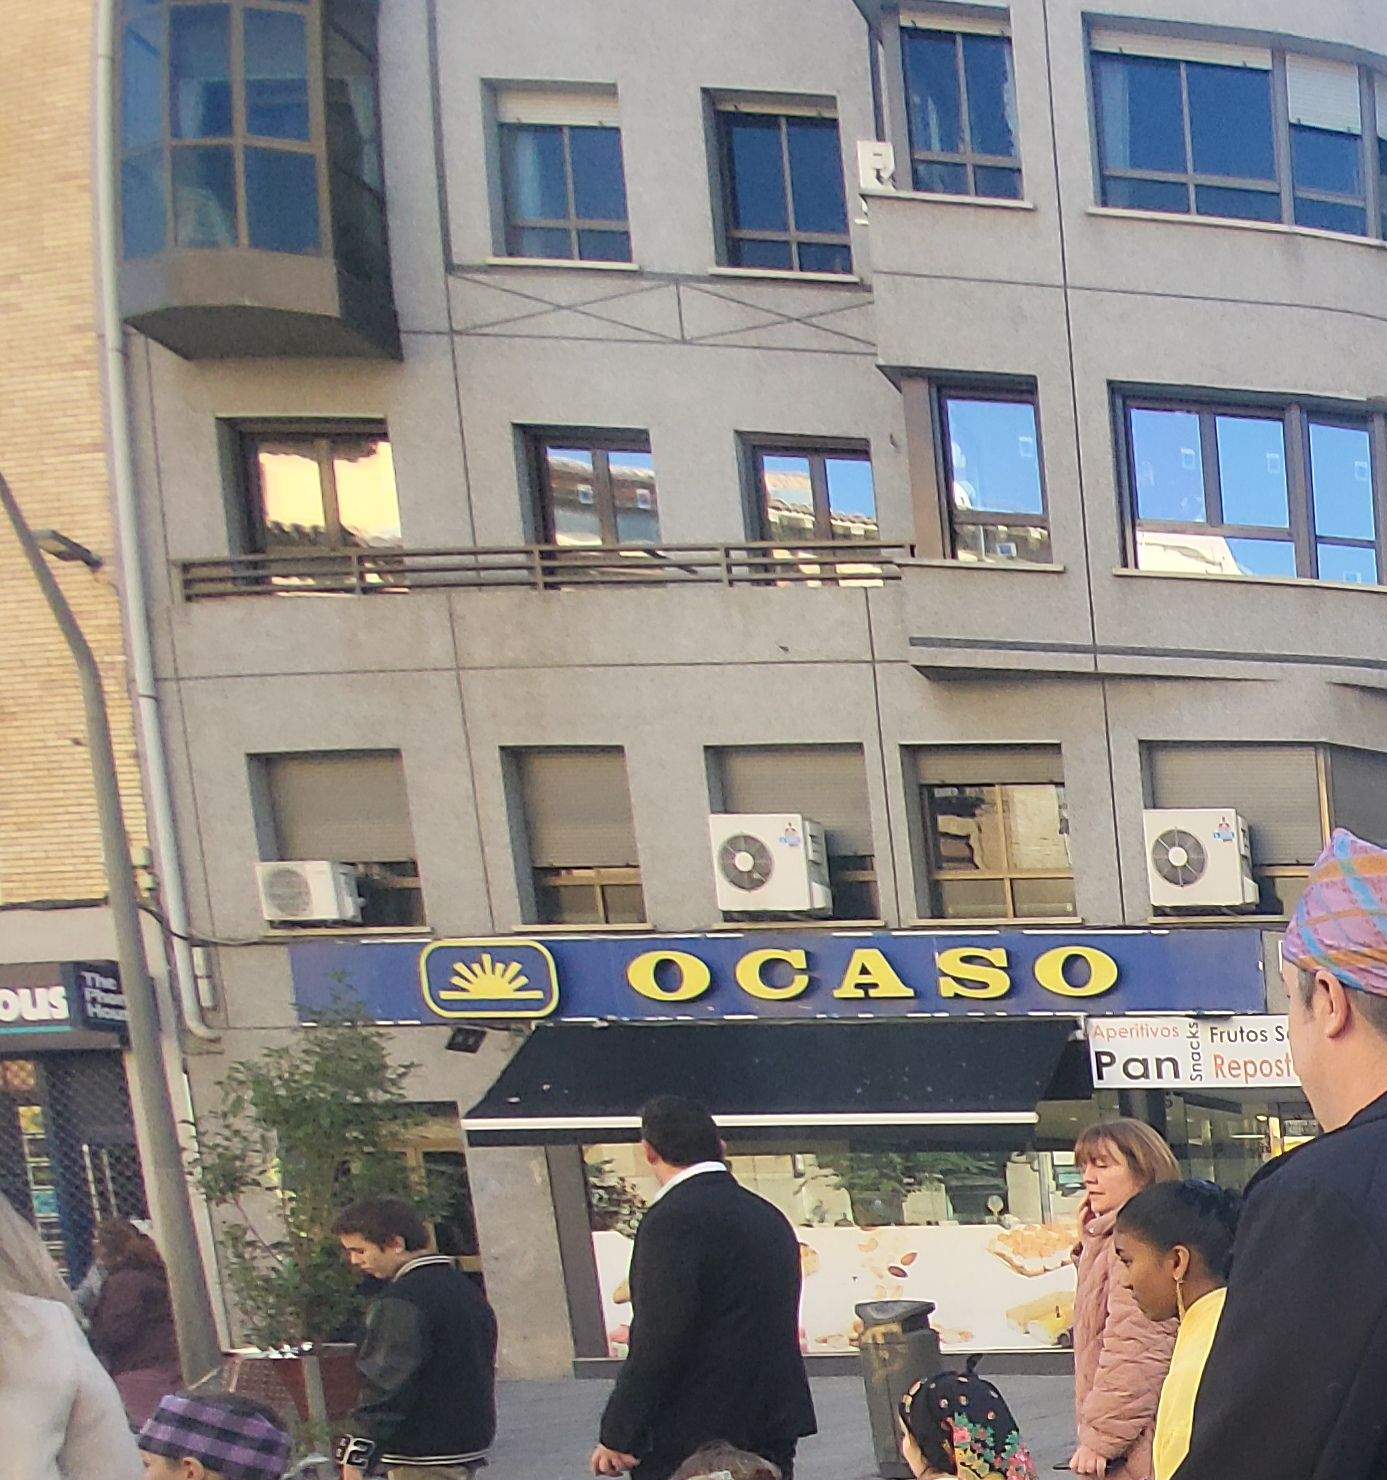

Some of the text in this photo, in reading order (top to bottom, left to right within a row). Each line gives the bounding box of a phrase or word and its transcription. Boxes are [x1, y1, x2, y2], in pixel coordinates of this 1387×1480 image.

[626, 945, 1119, 1001] OCASO
[1093, 1023, 1180, 1042] Aperitivos
[1210, 1025, 1289, 1043] Frutos S
[1095, 1050, 1181, 1081] Pan
[1186, 1021, 1203, 1082] Snacks
[1213, 1052, 1292, 1084] Repost
